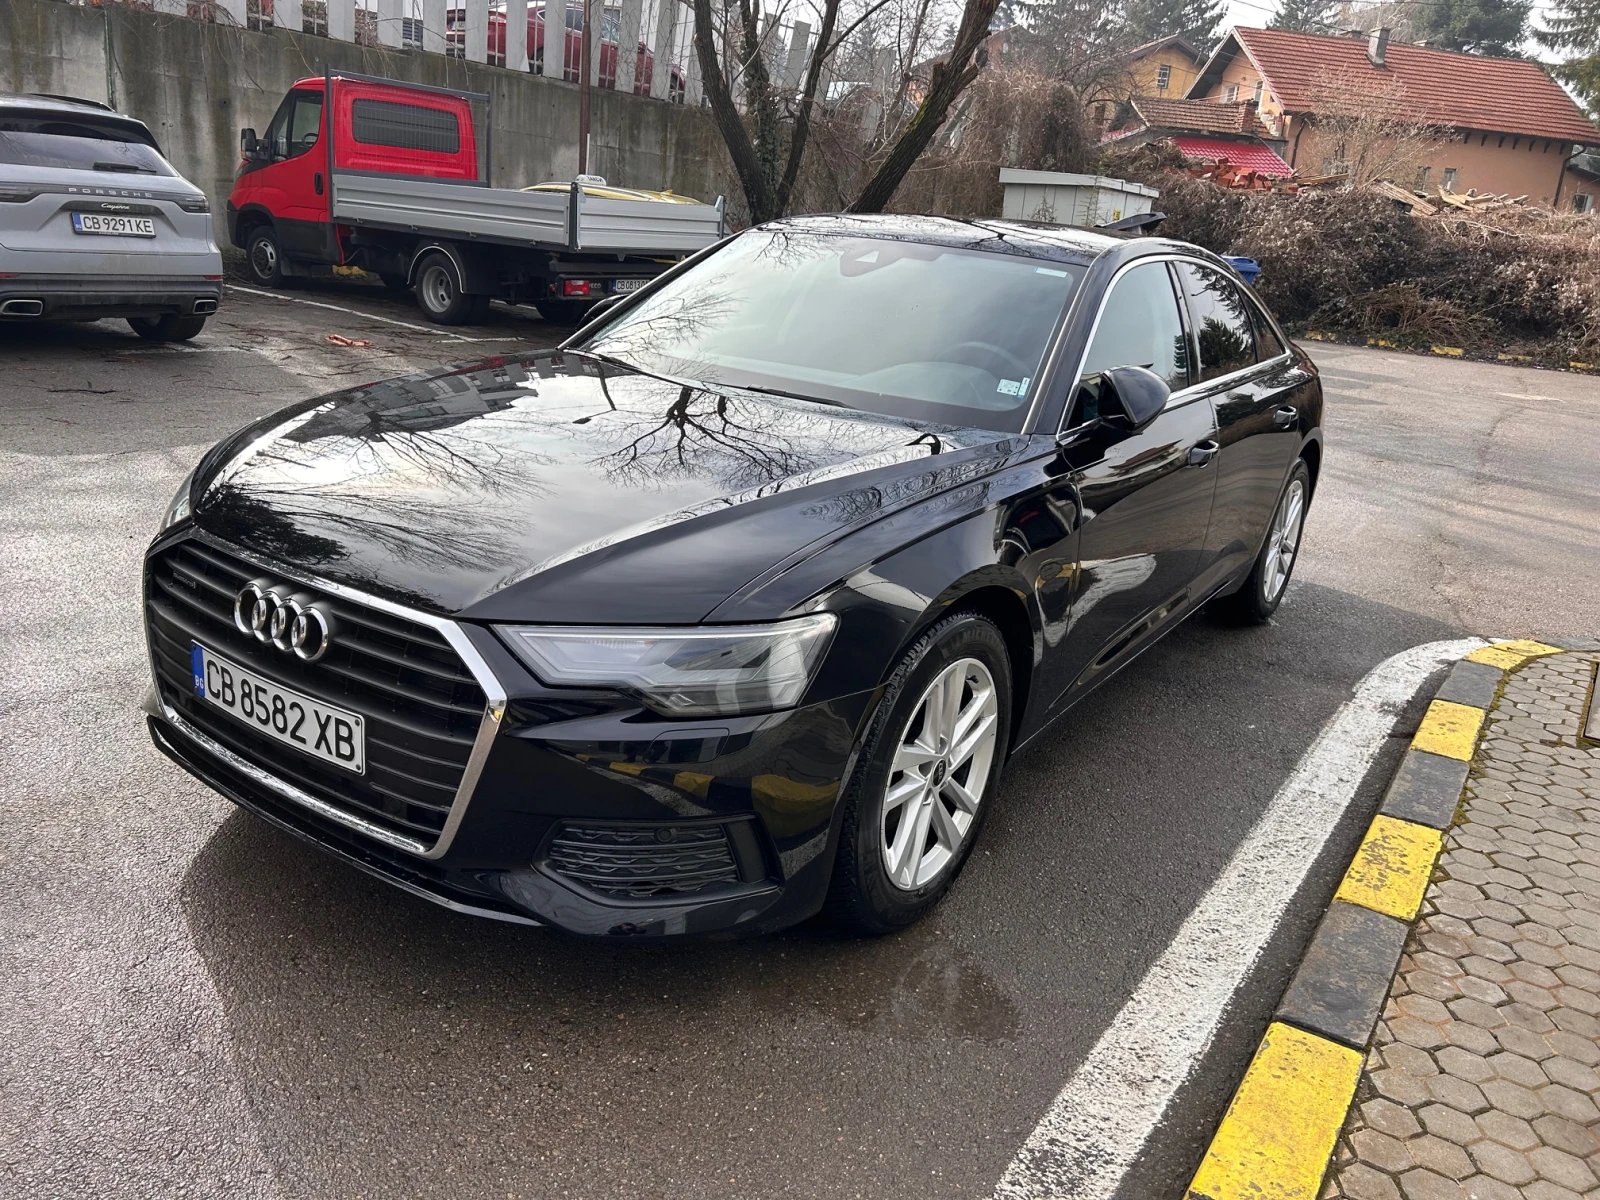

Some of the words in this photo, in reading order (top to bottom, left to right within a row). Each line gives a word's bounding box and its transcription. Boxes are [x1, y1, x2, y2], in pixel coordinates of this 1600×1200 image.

[68, 187, 153, 197] PORSCHE
[83, 216, 101, 230] CB
[102, 217, 133, 232] 9291
[135, 219, 153, 233] KE
[625, 280, 640, 290] 0813
[194, 674, 204, 689] BG
[206, 659, 236, 708] CB
[240, 678, 307, 745] 8582
[313, 709, 355, 762] XB
